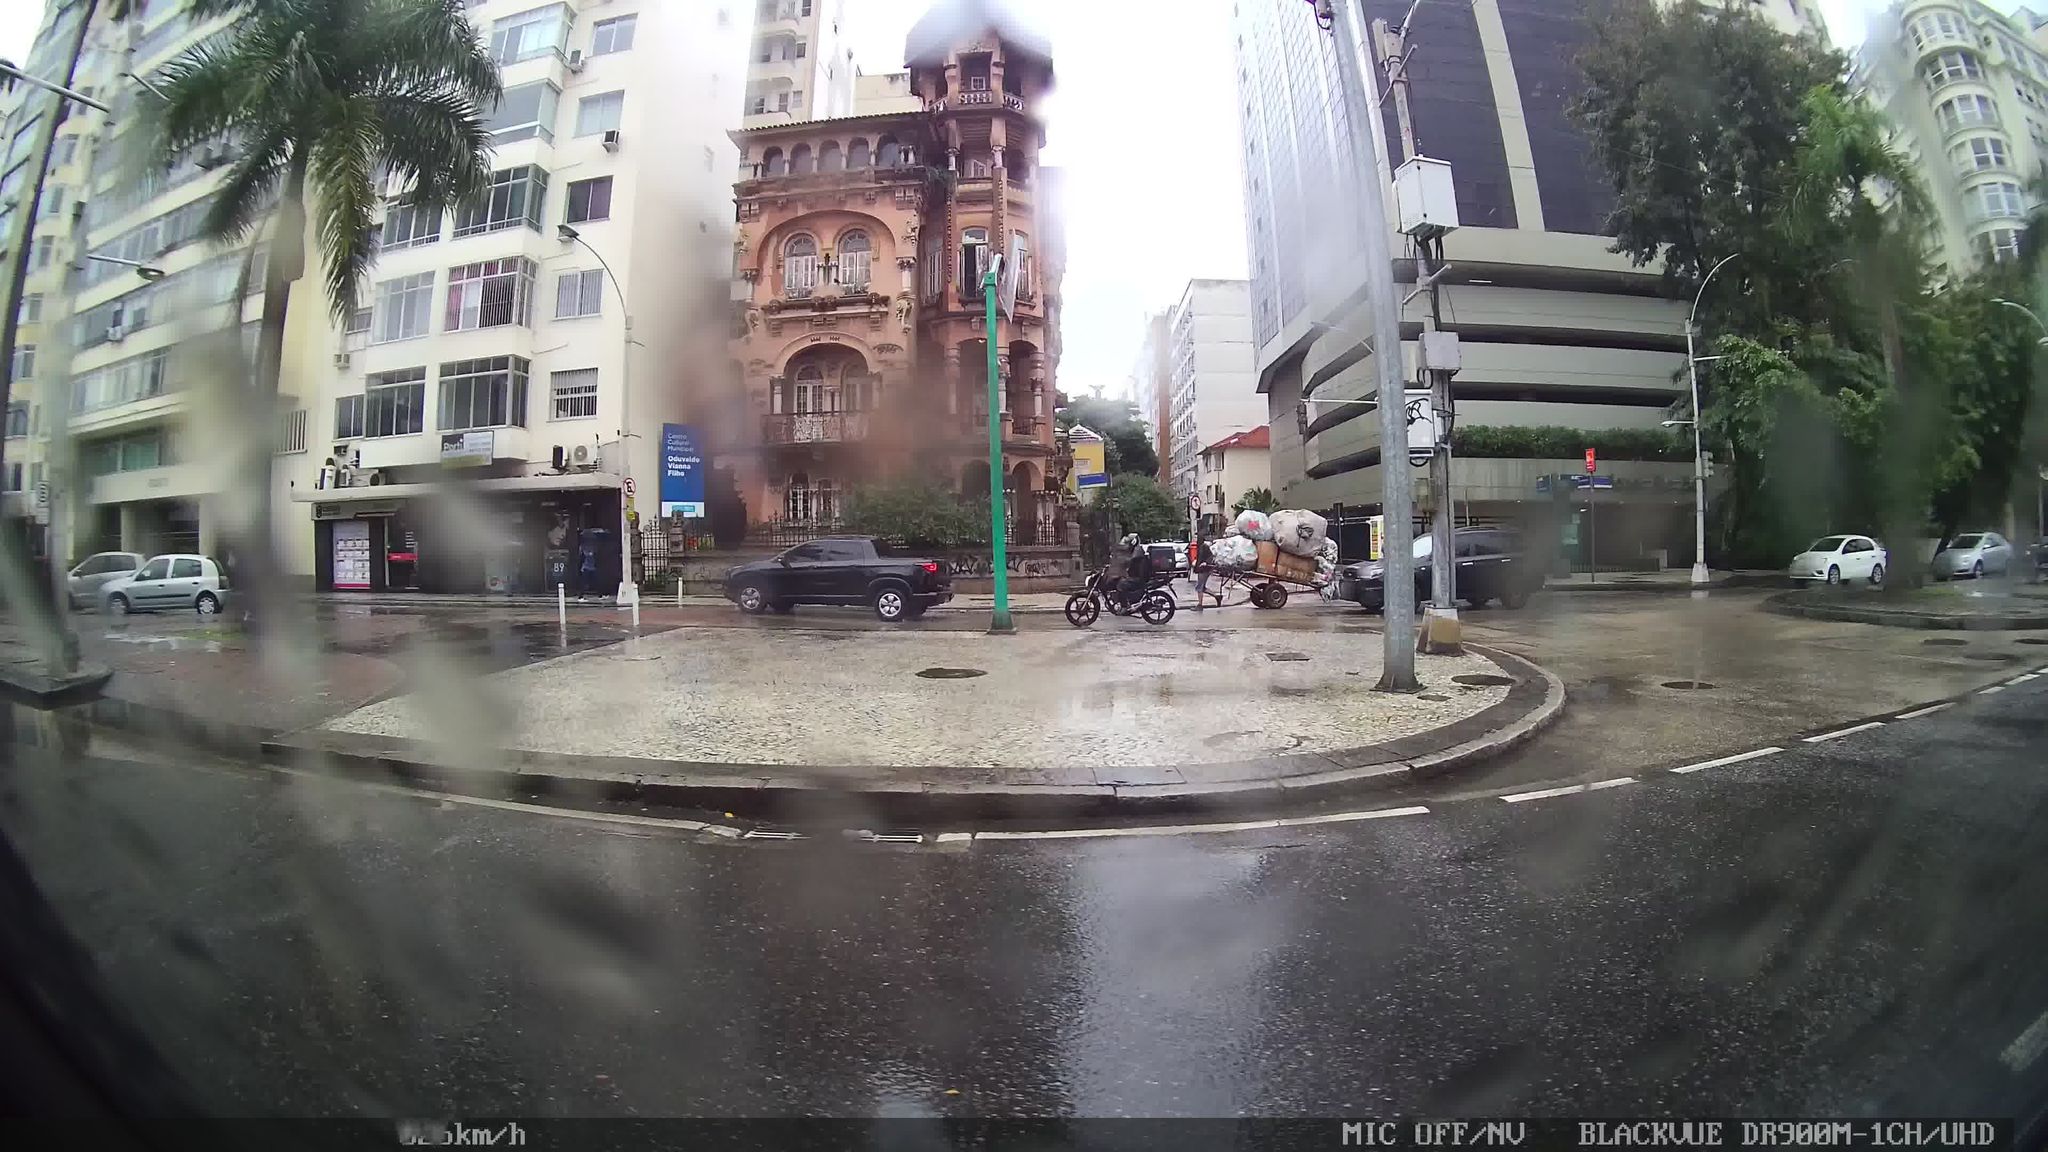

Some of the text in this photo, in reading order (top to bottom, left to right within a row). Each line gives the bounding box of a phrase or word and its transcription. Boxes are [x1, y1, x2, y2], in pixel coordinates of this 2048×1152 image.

[667, 455, 701, 463] Oduvaldo
[667, 469, 685, 477] Filho
[553, 562, 565, 573] 89
